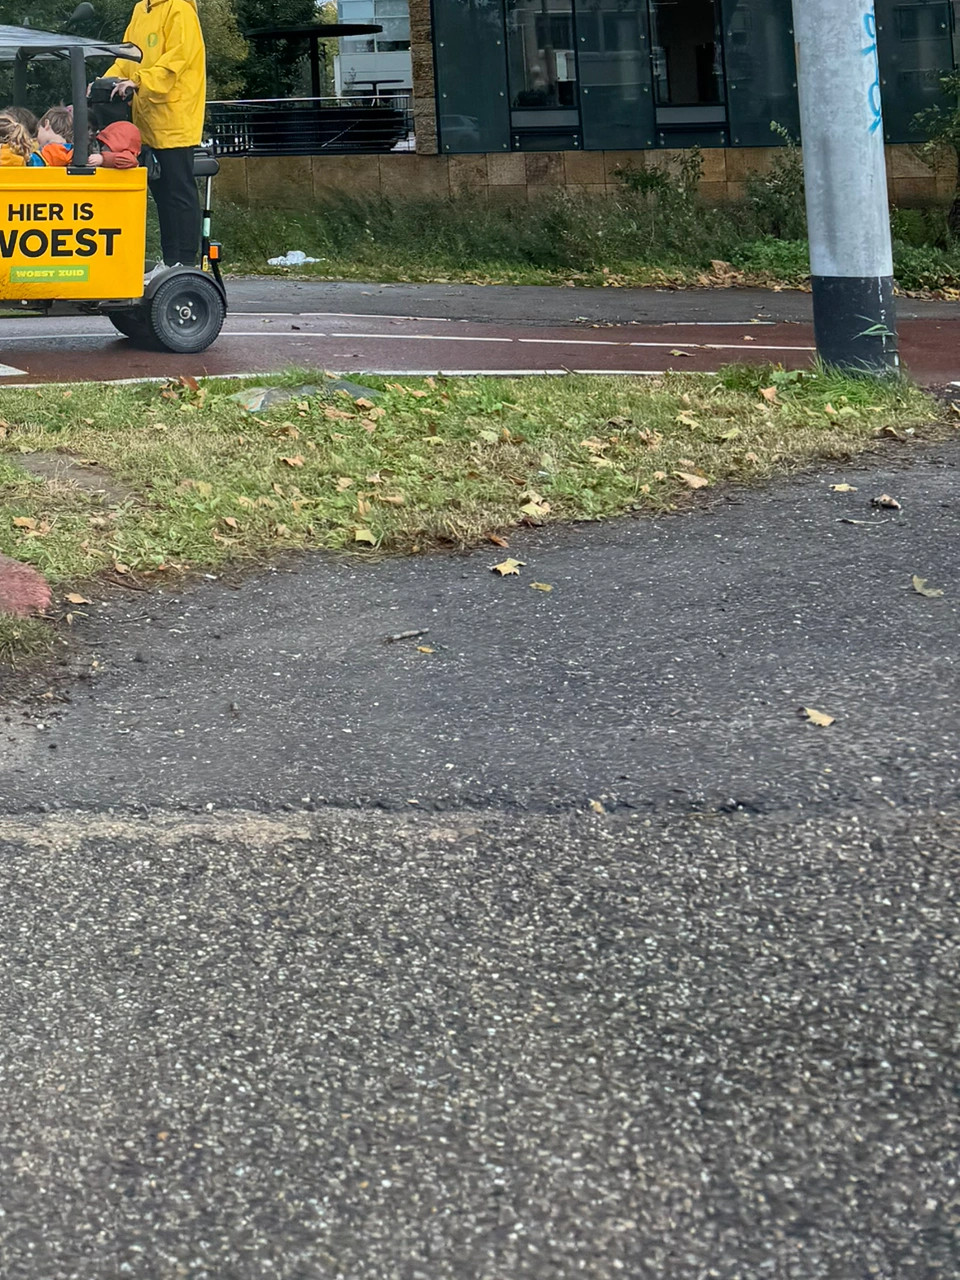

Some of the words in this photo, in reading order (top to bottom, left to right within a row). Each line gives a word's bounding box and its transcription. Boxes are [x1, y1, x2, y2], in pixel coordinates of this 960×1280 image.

[8, 203, 64, 222] HIER
[73, 203, 94, 221] IS
[16, 270, 55, 278] WOEST
[58, 269, 85, 277] ZUID
